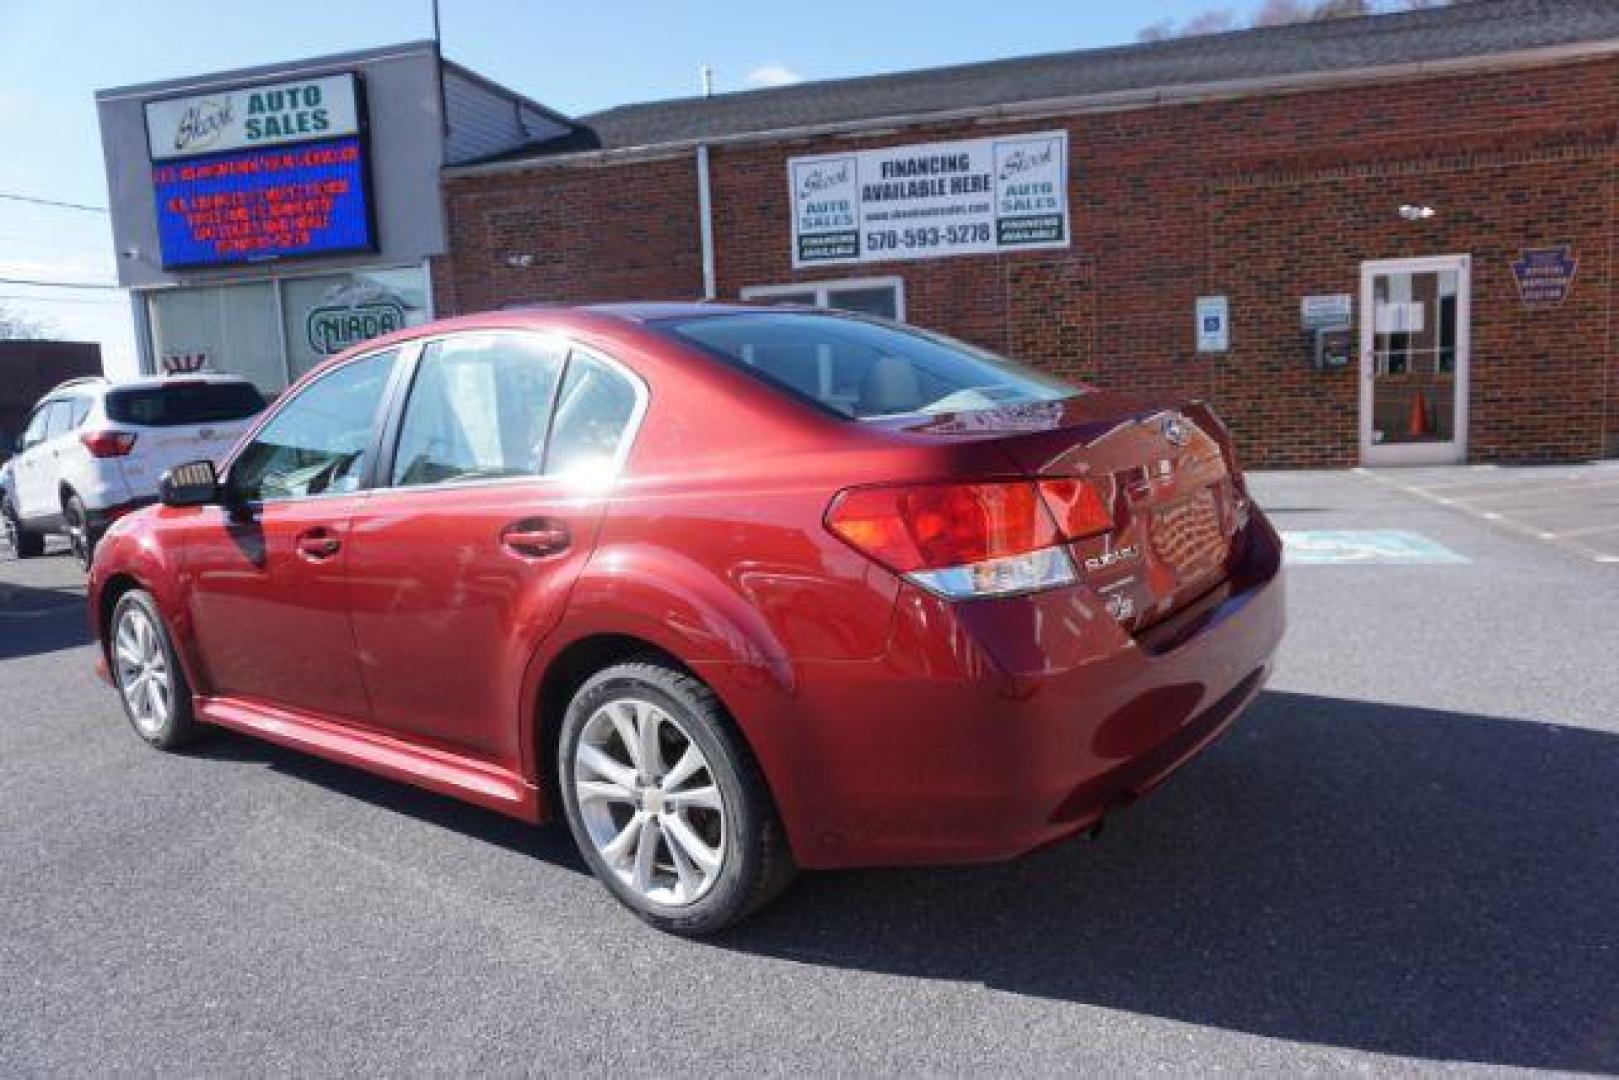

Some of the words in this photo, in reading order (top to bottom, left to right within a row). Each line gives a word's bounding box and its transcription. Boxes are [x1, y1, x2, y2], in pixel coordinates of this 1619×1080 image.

[248, 85, 322, 115] AUTO
[244, 108, 329, 141] SALES
[881, 152, 969, 180] FINANCING
[862, 179, 946, 202] AVAILABLE
[951, 173, 992, 196] HERE
[1007, 182, 1052, 197] AUTO
[807, 200, 850, 215] AUTO
[1001, 195, 1056, 212] SALES
[801, 213, 853, 230] SALES
[867, 222, 990, 251] 570-593-5278
